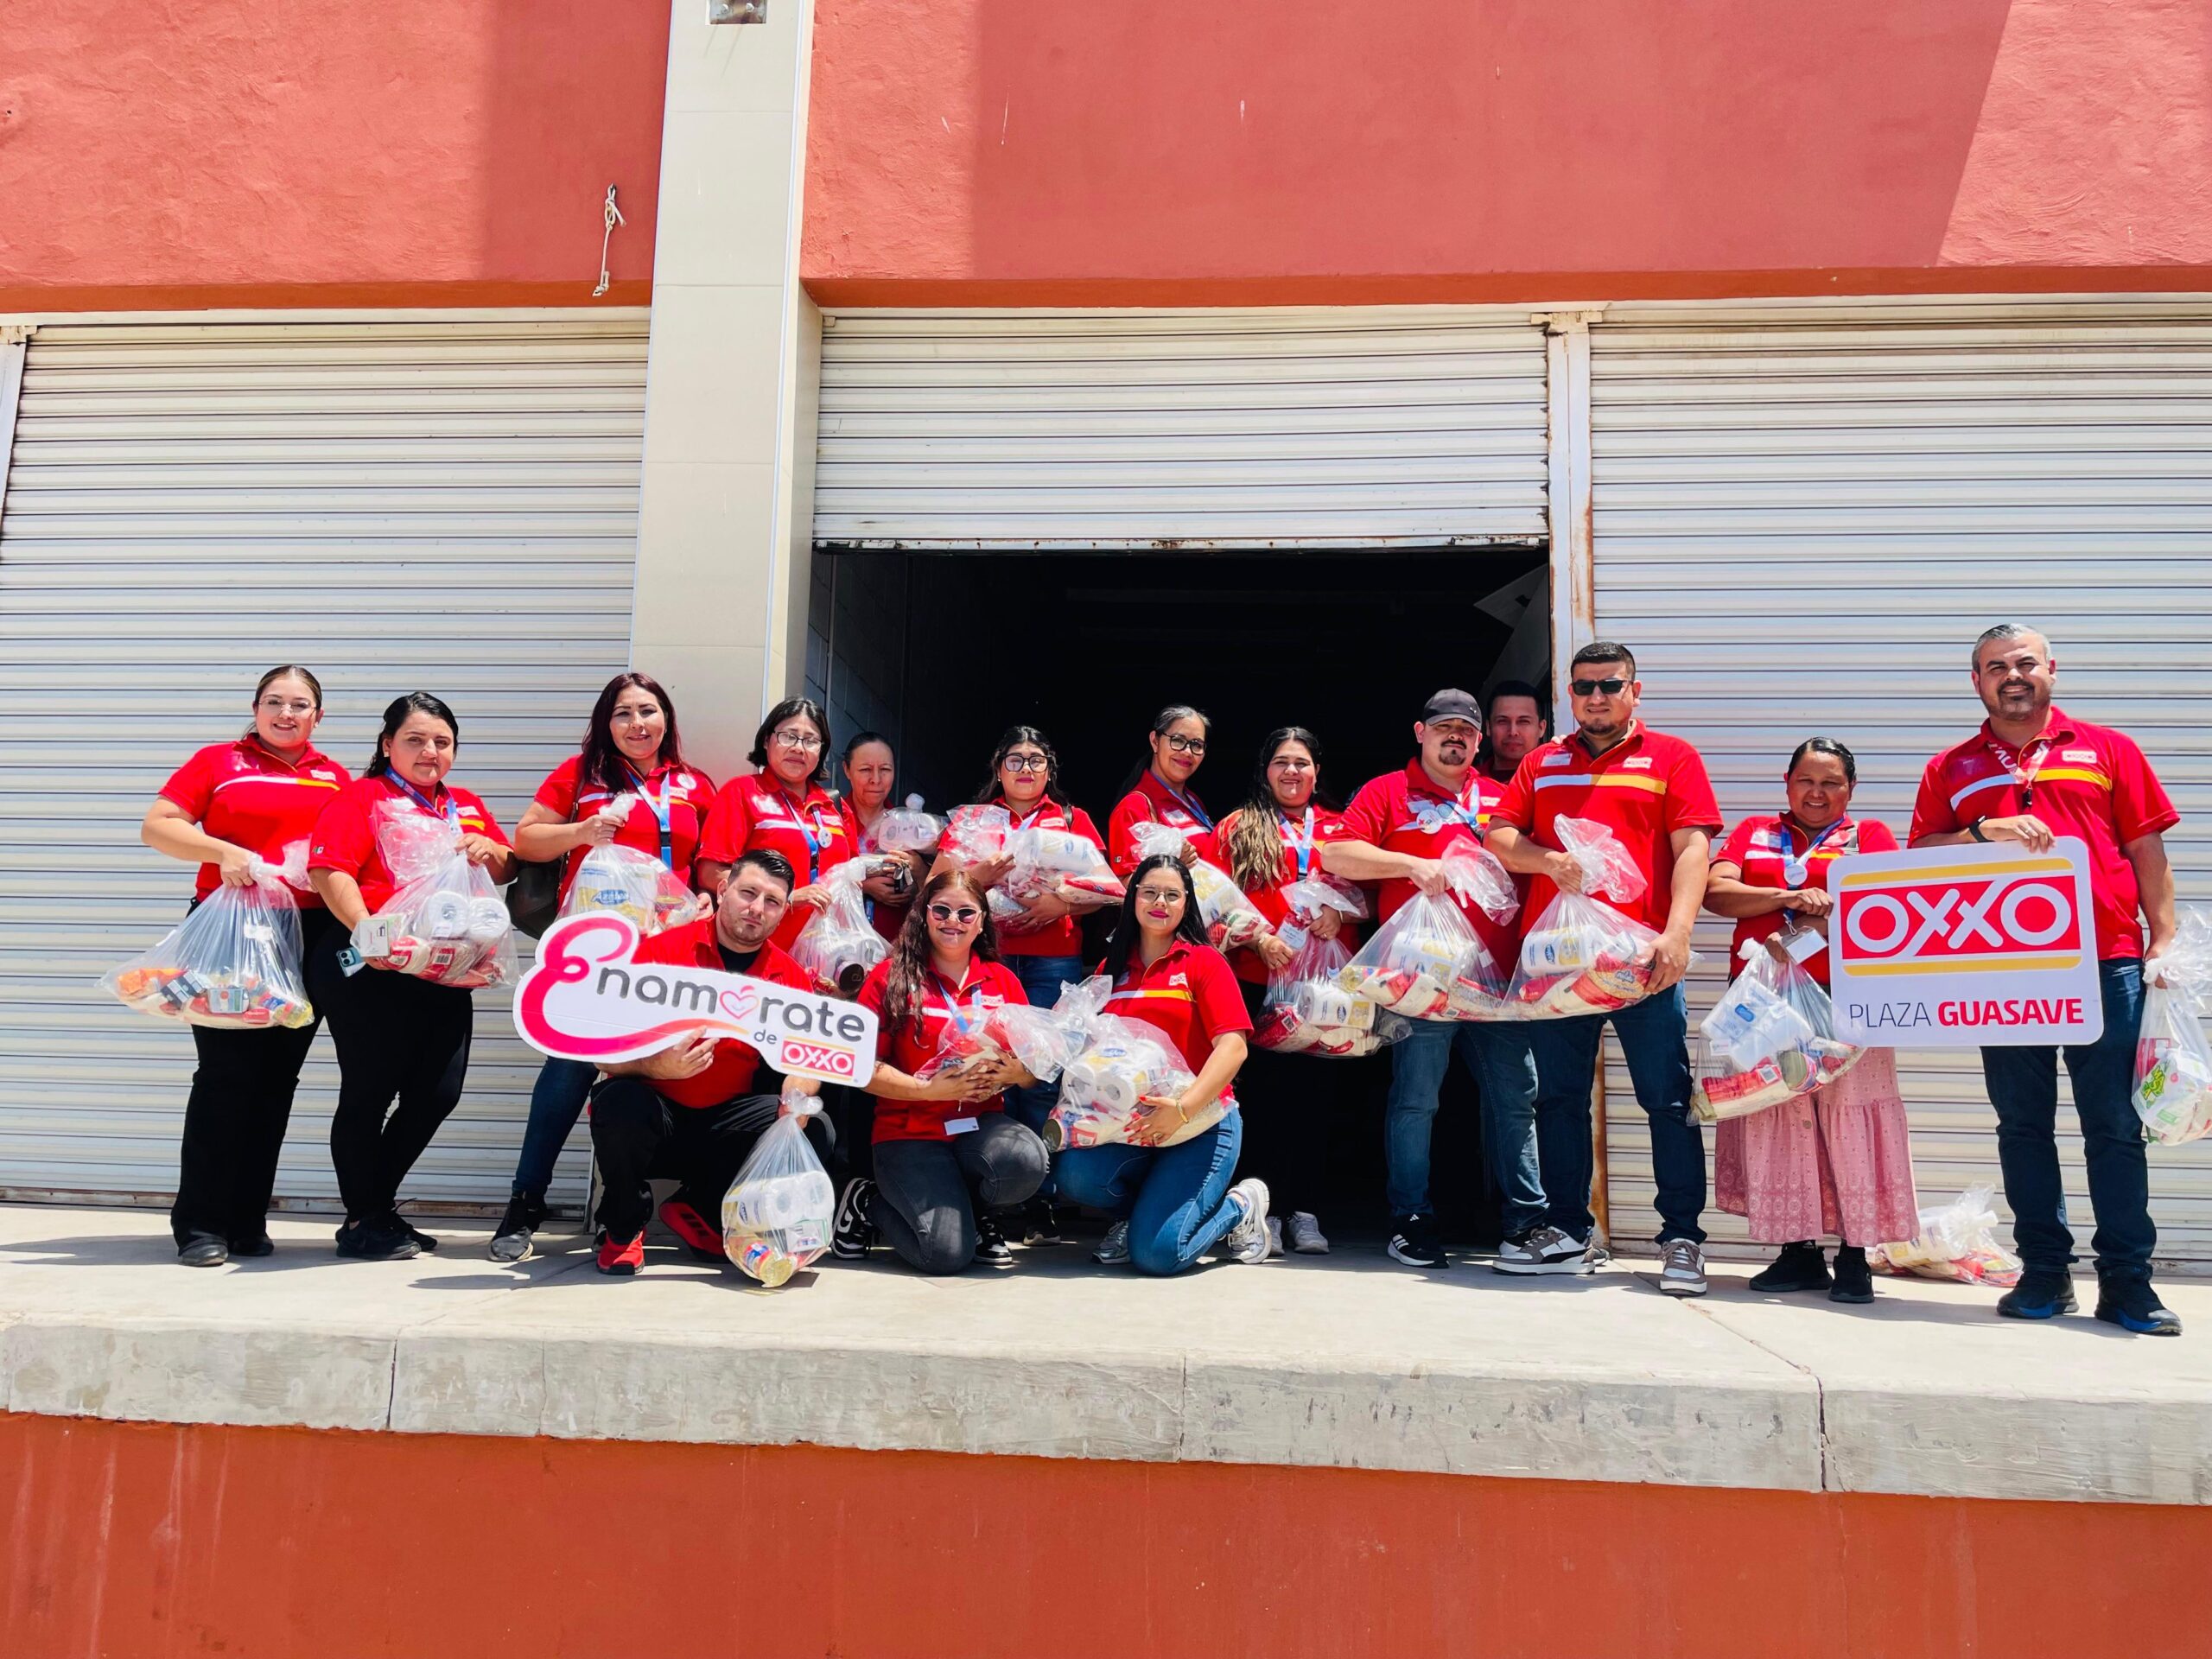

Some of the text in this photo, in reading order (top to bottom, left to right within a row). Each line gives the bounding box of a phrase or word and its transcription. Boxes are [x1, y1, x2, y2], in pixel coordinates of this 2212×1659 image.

[1847, 880, 2072, 956] OXXO
[1849, 998, 2085, 1029] PLAZA GUASAVE
[753, 1028, 778, 1046] de
[783, 1043, 855, 1075] OXXO
